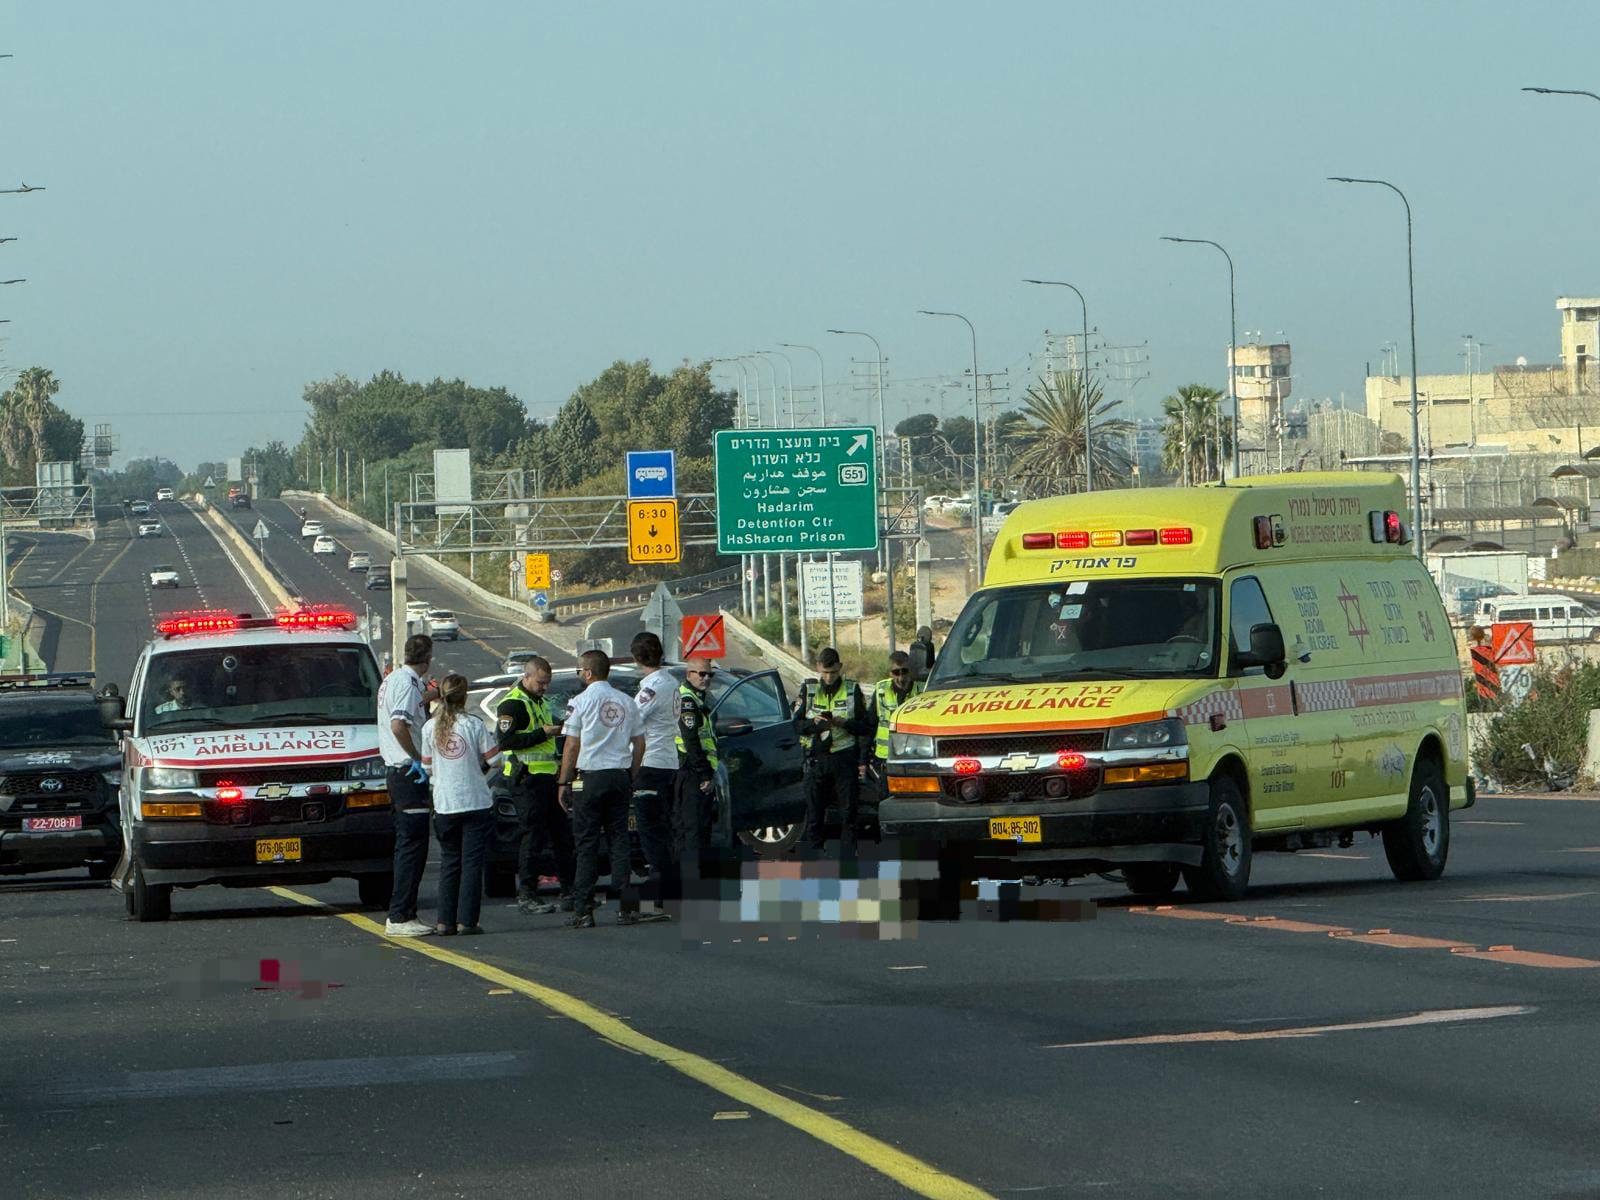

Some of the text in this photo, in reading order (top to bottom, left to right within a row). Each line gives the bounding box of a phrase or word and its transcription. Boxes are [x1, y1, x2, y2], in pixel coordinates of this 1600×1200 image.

[731, 437, 840, 449] בית מעצר הדרים
[751, 452, 821, 466] כלא השרון
[792, 467, 827, 481] موقف
[844, 469, 864, 480] 551
[797, 486, 827, 498] سجن
[638, 508, 667, 519] 6:30
[757, 502, 814, 513] Hadarim
[738, 516, 833, 529] Detention Ctr
[727, 531, 845, 545] HaSharon Prison
[636, 543, 672, 554] 10:30
[1050, 557, 1137, 573] פראמדיק
[950, 690, 1011, 702] אדום
[1025, 687, 1068, 696] דוד
[1078, 685, 1124, 697] מגן
[941, 696, 1115, 717] AMBULANCE
[193, 733, 246, 745] אדום
[257, 731, 296, 741] דוד
[308, 730, 344, 739] מגן
[154, 742, 185, 754] 1071
[195, 739, 346, 756] AMBULANCE
[1330, 769, 1346, 789] 101
